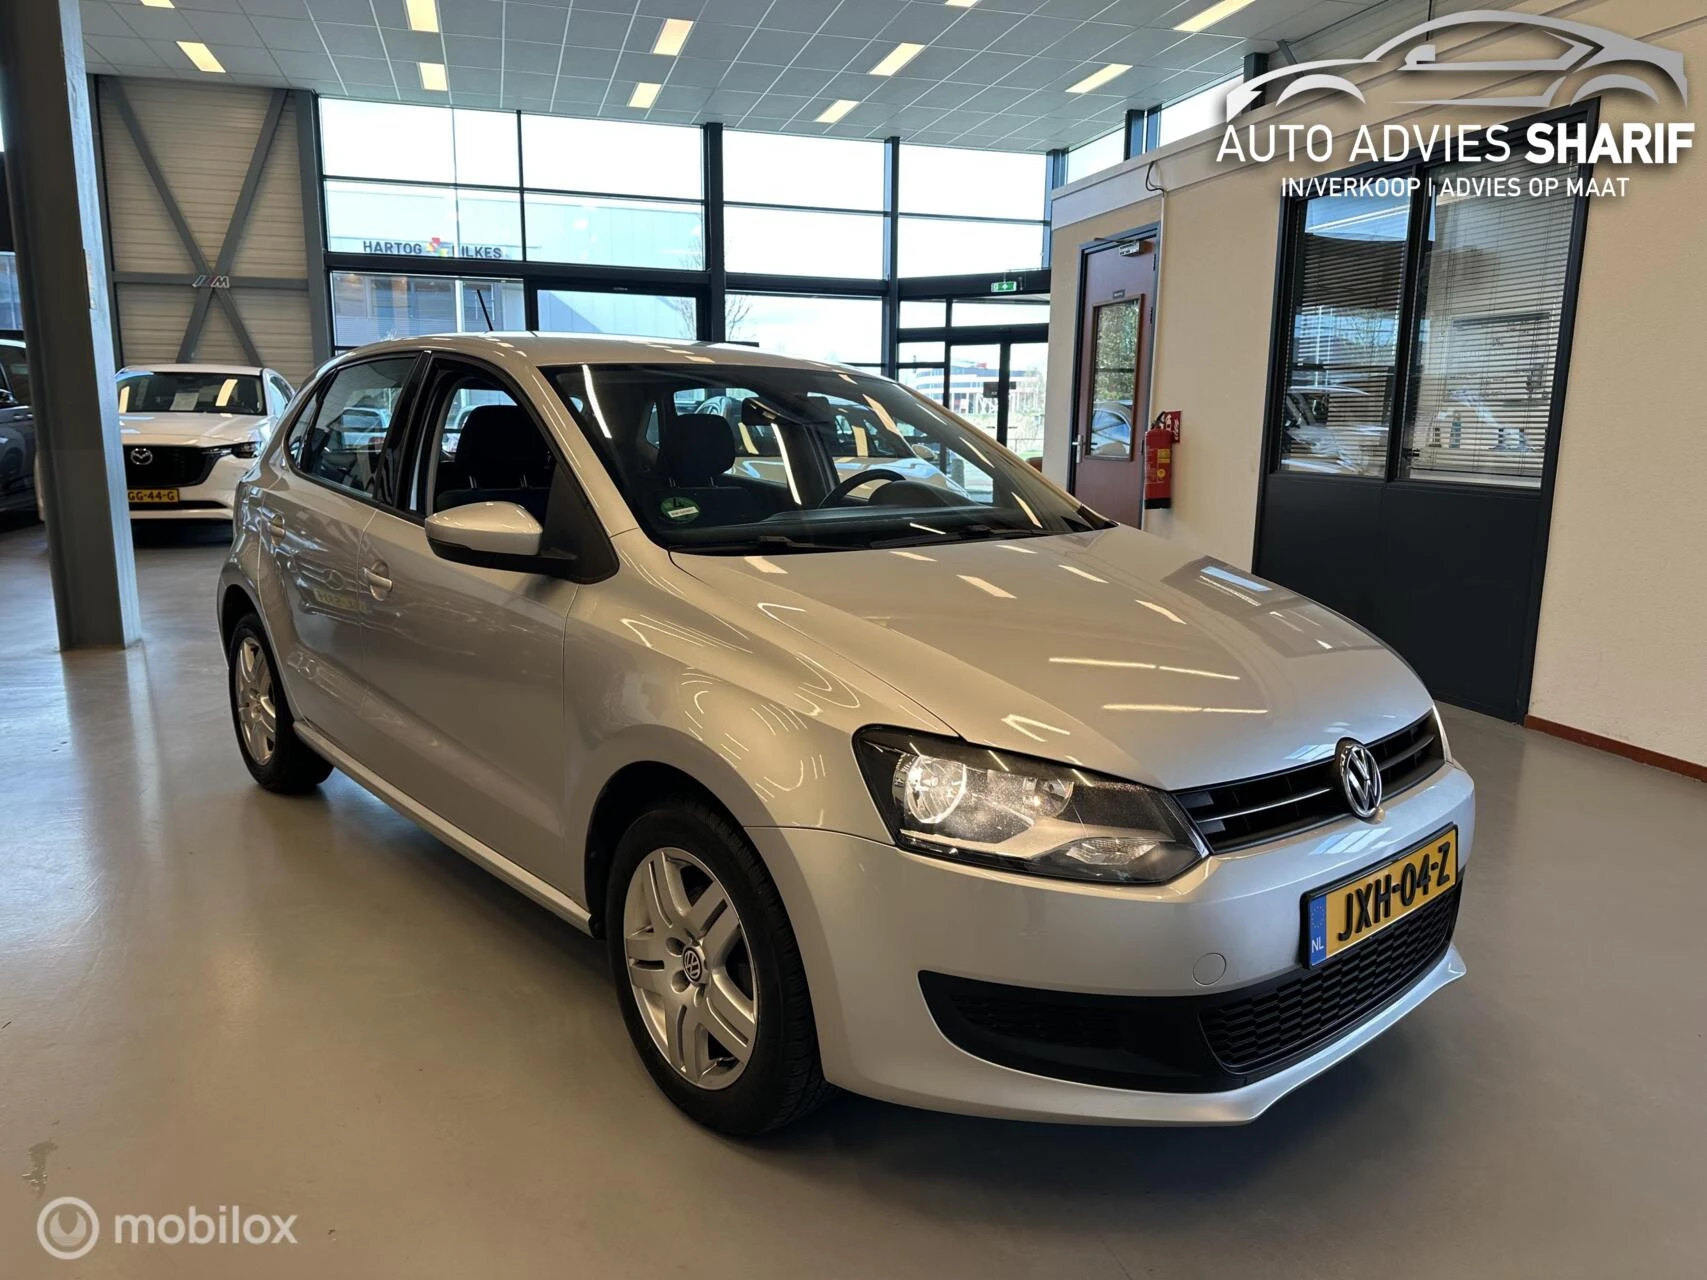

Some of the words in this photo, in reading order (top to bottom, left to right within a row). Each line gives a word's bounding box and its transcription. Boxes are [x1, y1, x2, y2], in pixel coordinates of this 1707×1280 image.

[363, 240, 422, 255] HARTOG
[127, 491, 175, 501] GG-44-G
[1337, 841, 1451, 942] JXH-04-Z
[1311, 936, 1325, 953] NL
